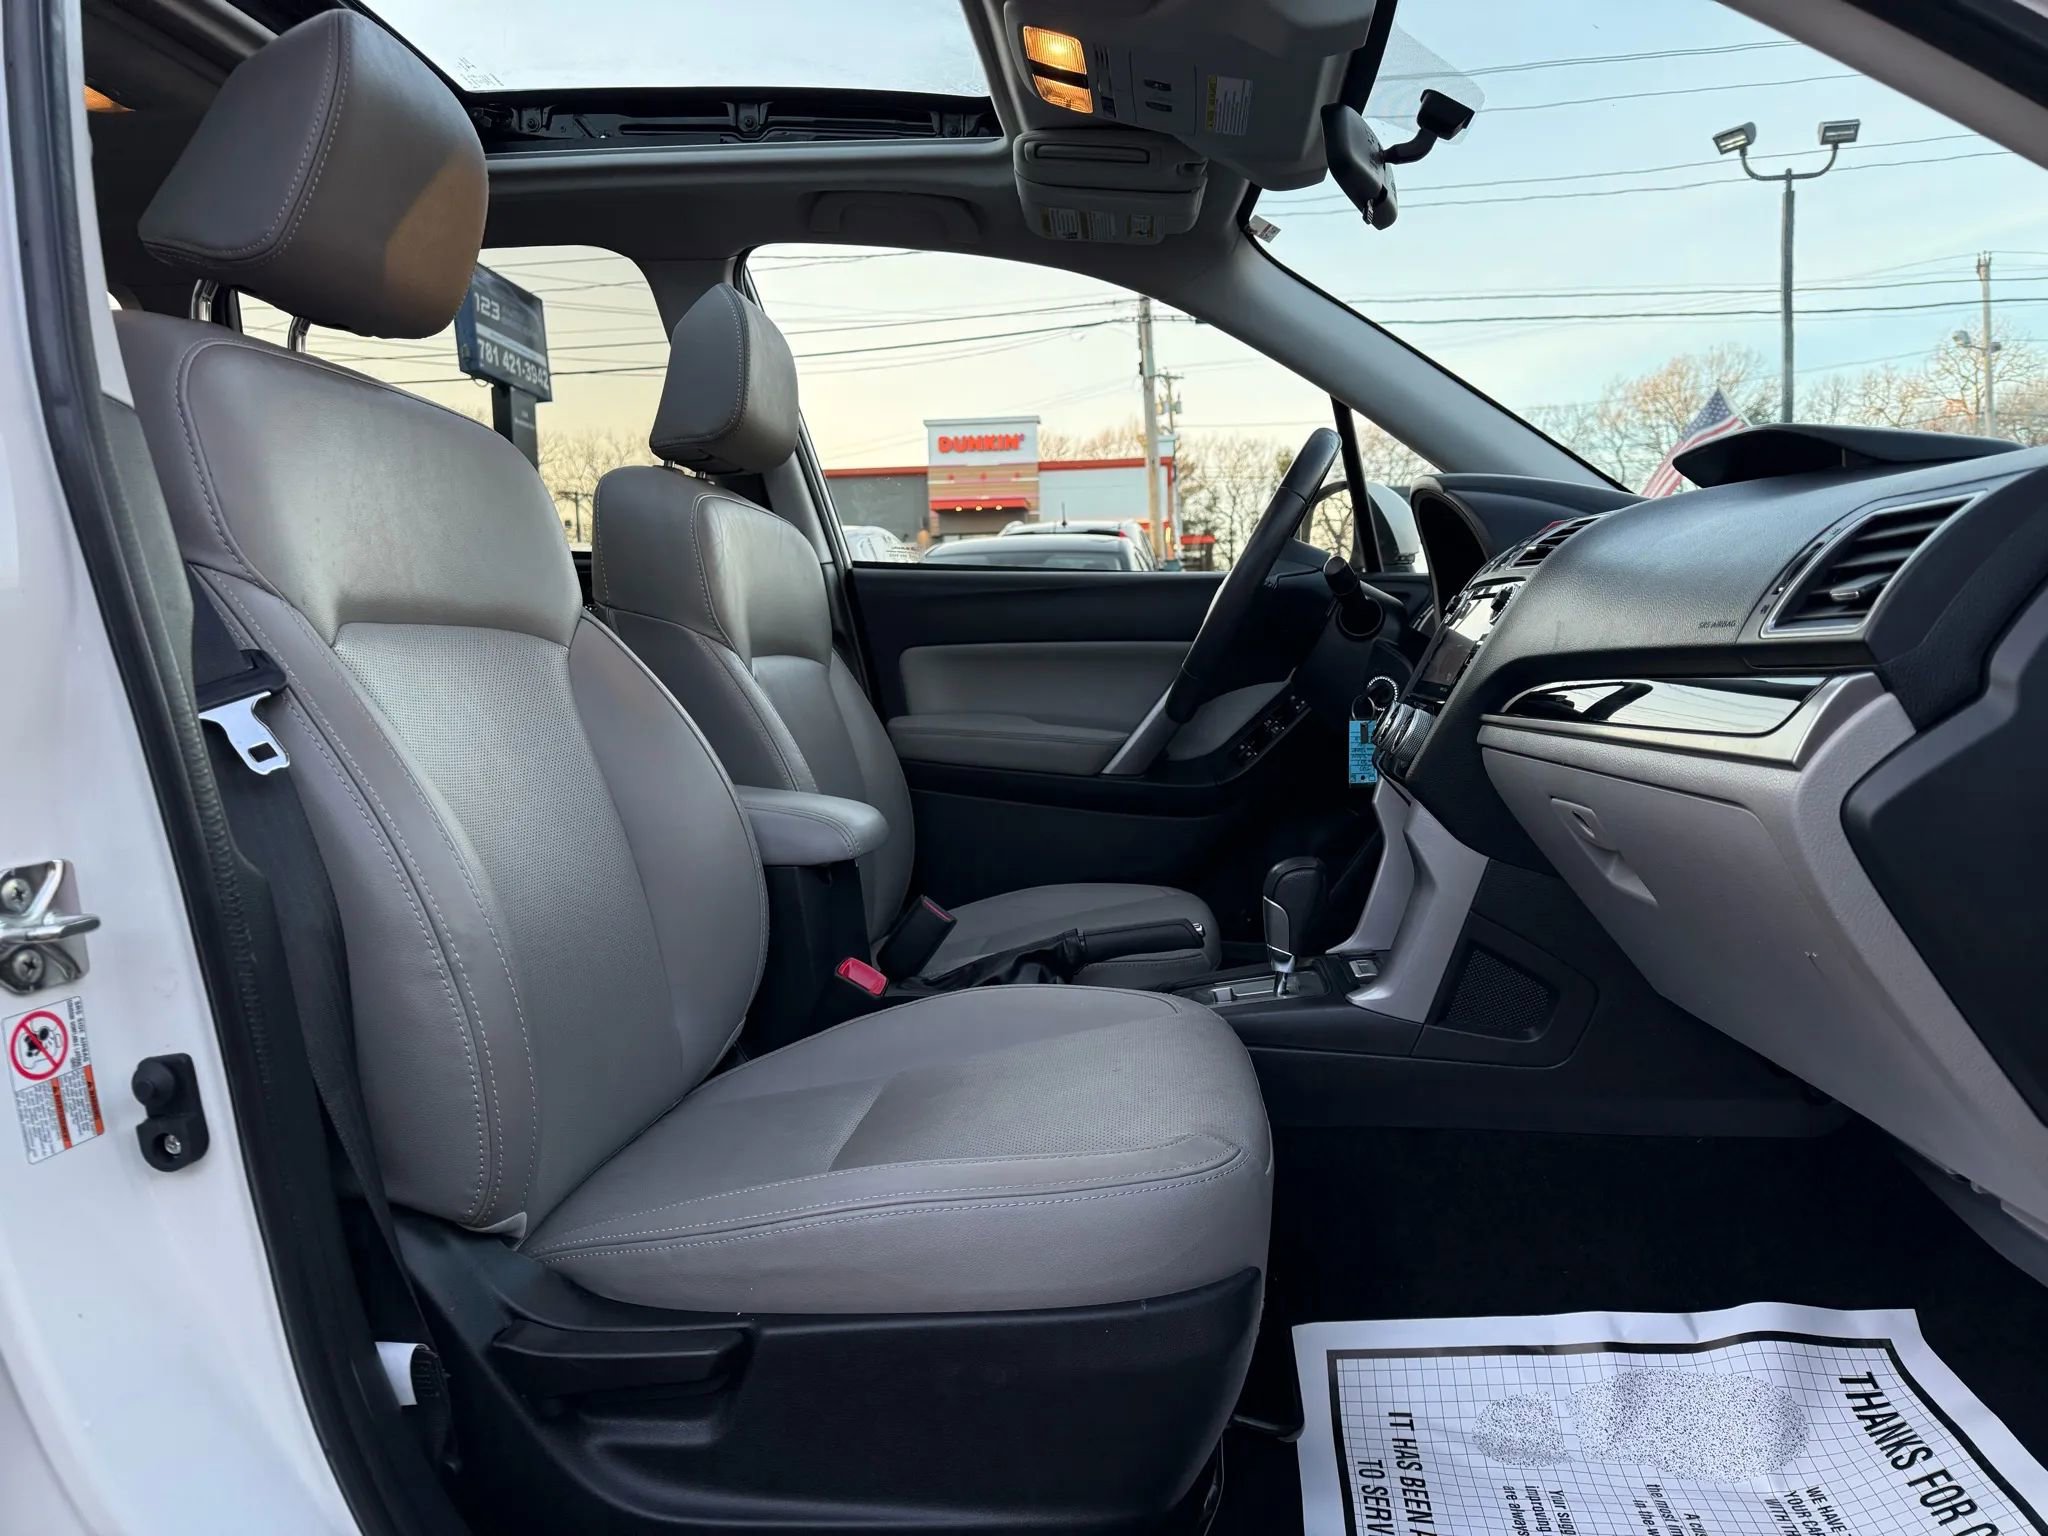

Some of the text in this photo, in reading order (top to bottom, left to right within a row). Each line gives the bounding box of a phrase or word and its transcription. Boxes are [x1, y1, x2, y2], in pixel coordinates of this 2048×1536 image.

[474, 292, 500, 320] 123
[477, 338, 500, 367] 781
[1711, 620, 1738, 629] AIRBAG
[1388, 1412, 1415, 1431] IT
[1391, 1437, 1423, 1471] HAS
[1839, 1371, 1934, 1470] THANKS
[1906, 1468, 1978, 1526] FOR
[1357, 1459, 1395, 1536] TO SERV
[1399, 1476, 1434, 1524] BEEN
[1503, 1485, 1531, 1536] are always
[1525, 1485, 1552, 1532] improving
[1548, 1490, 1568, 1510] Your
[1633, 1500, 1648, 1508] in
[1646, 1484, 1663, 1498] the
[1655, 1500, 1679, 1522] most
[1764, 1499, 1792, 1521] WITH
[1784, 1490, 1812, 1518] YOUR
[1806, 1486, 1848, 1533] WE HAVE
[1638, 1511, 1655, 1525] the
